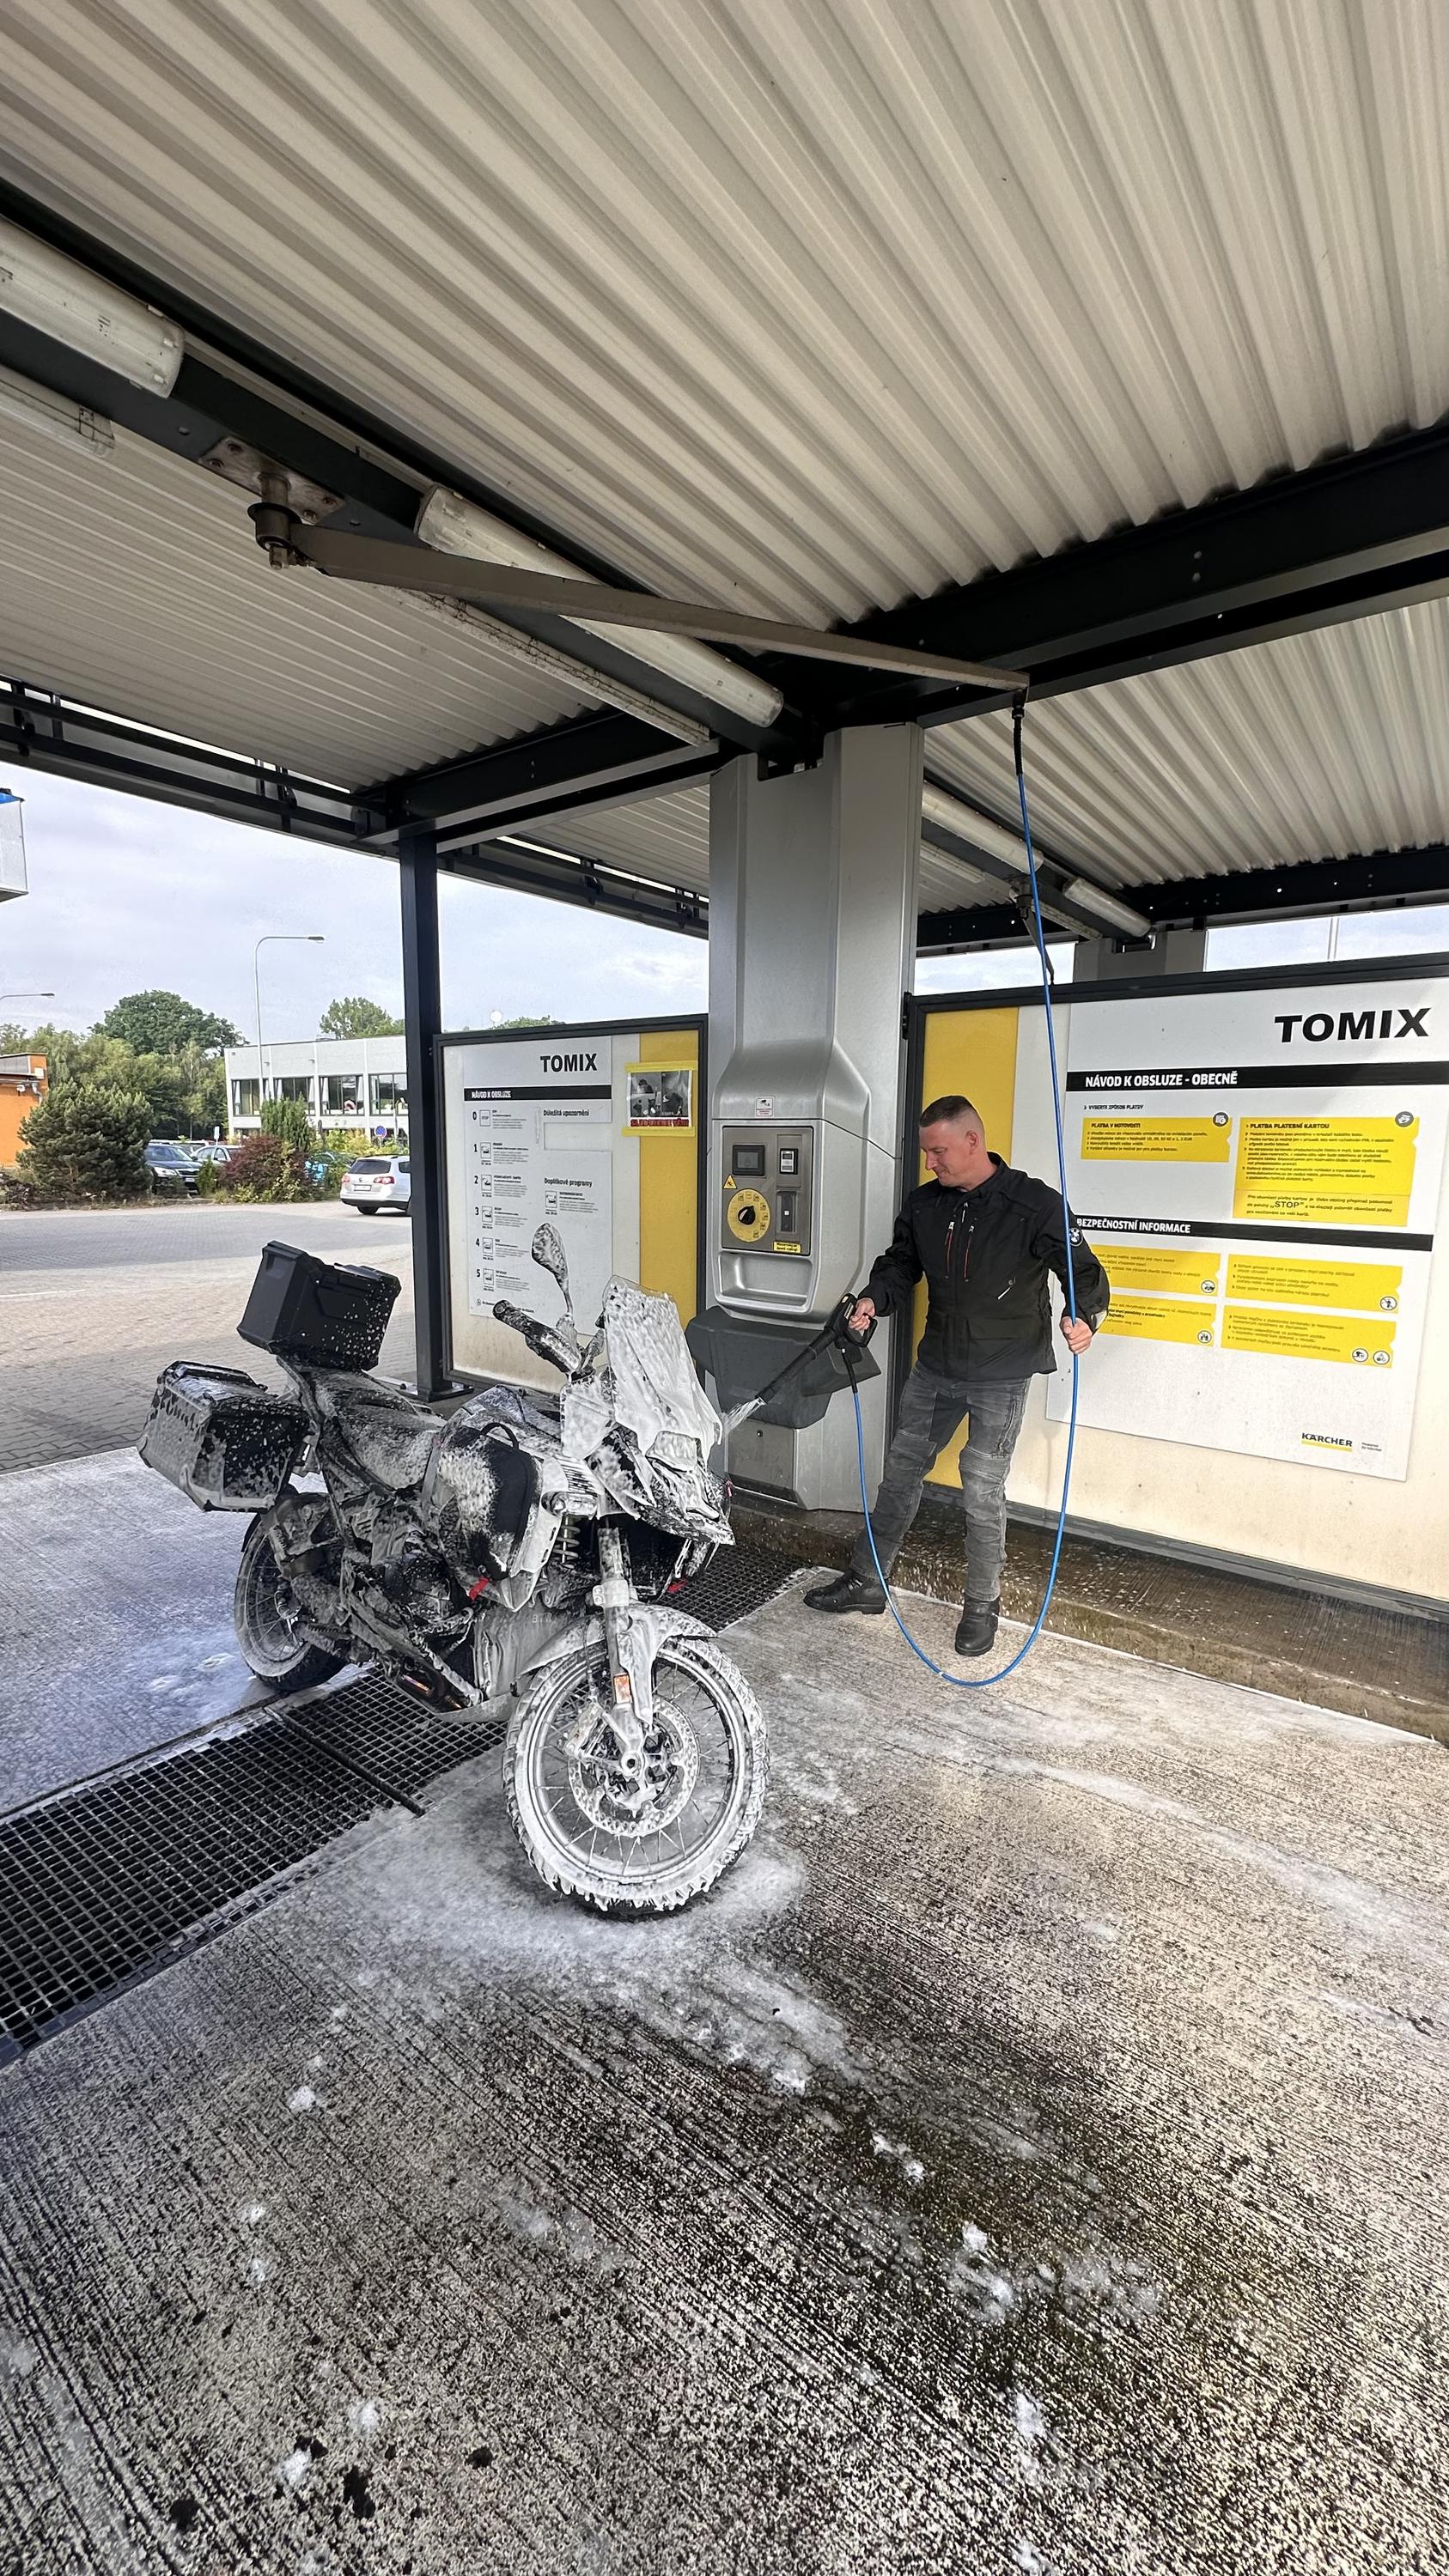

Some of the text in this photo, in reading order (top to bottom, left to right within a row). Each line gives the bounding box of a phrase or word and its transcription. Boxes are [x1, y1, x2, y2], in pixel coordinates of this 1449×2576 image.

[1274, 1007, 1432, 1042] TOMIX
[539, 1053, 598, 1072] TOMIX
[1085, 1074, 1122, 1087] NÁVOD
[1123, 1076, 1131, 1087] K
[1134, 1074, 1183, 1086] OBSLUZE
[1191, 1070, 1238, 1085] OBECNĚ
[472, 1090, 487, 1098] NÁVOD
[472, 1111, 478, 1121] 0
[473, 1144, 478, 1152] 1
[474, 1176, 478, 1184] 2
[569, 1180, 593, 1188] programy
[474, 1206, 479, 1216] 3
[1076, 1218, 1191, 1234] BEZPEČNOSTNÍ INFORMACE
[475, 1237, 480, 1247] 4
[476, 1268, 481, 1278] 5
